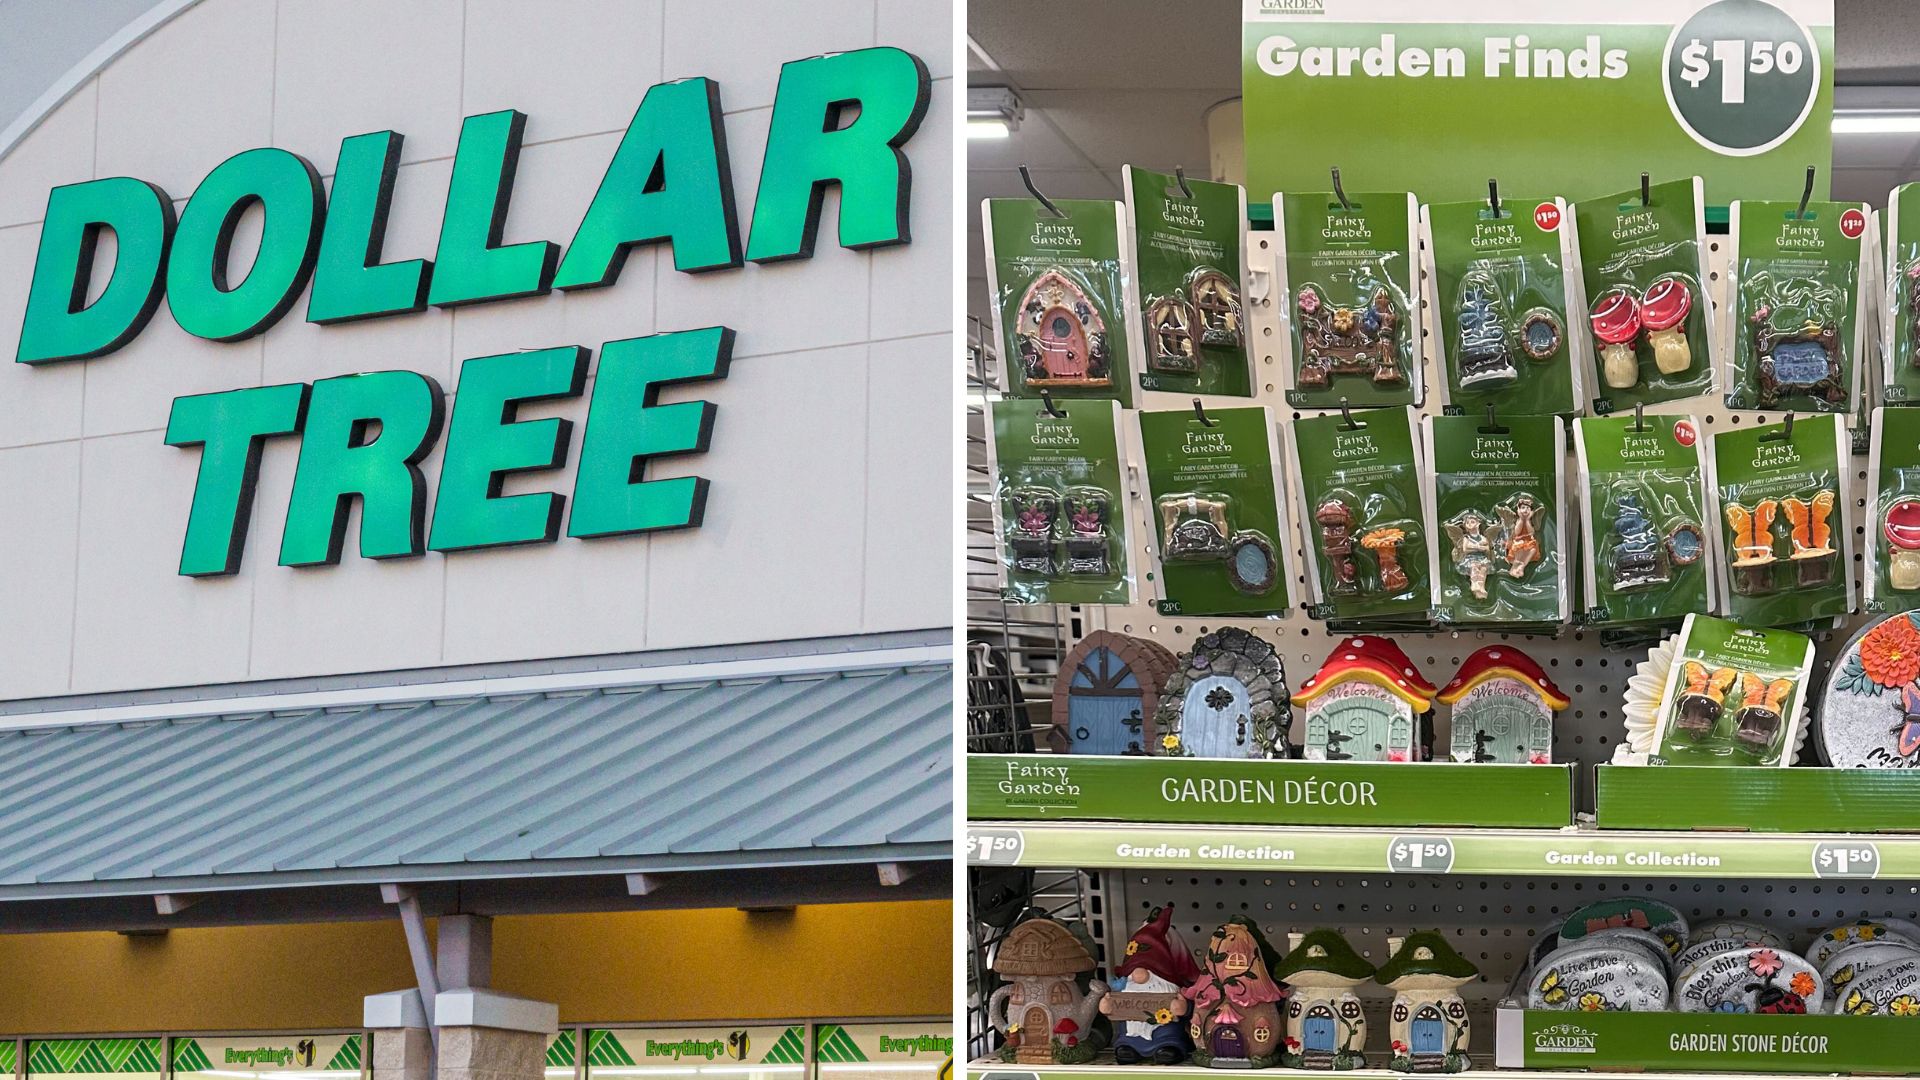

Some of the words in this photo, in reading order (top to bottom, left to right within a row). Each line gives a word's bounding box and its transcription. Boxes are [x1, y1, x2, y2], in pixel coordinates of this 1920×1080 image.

[1256, 34, 1465, 76] Garden
[1485, 35, 1628, 79] Finds
[16, 46, 931, 366] DOLLAR
[1164, 199, 1198, 219] Fairy
[1162, 211, 1205, 226] Garden
[1327, 216, 1365, 230] Fairy
[1616, 212, 1652, 229] Fairy
[1035, 222, 1074, 238] Fairy
[1322, 228, 1371, 238] Garden
[1475, 224, 1514, 237] Fairy
[1612, 222, 1660, 240] Garden
[1782, 224, 1819, 240] Fairy
[1031, 234, 1081, 245] Garden
[1471, 235, 1521, 246] Garden
[1776, 237, 1825, 247] Garden
[1142, 376, 1159, 388] 2PC
[1290, 393, 1307, 403] 1PC
[1596, 400, 1612, 411] 2PC
[1035, 423, 1073, 438] Fairy
[1031, 434, 1080, 445] Garden
[1186, 432, 1224, 446] Fairy
[1336, 435, 1371, 449] Fairy
[1476, 438, 1513, 453] Fairy
[1624, 437, 1658, 450] Fairy
[164, 325, 737, 577] TREE
[1181, 443, 1232, 454] Garden
[1332, 446, 1379, 458] Garden
[1471, 449, 1519, 459] Garden
[1620, 448, 1665, 458] Garden
[1757, 444, 1794, 459] Fairy
[1752, 454, 1801, 468] Garden
[1162, 602, 1181, 612] 2PC
[1319, 606, 1336, 615] 2PC
[1435, 607, 1453, 617] 2PC
[1868, 600, 1886, 610] 2PC
[1592, 609, 1607, 619] 2PC
[1723, 641, 1770, 655] Garden
[1731, 635, 1766, 651] Fairy
[1328, 681, 1387, 701] Welcome
[1472, 678, 1529, 701] Welcome
[1006, 762, 1069, 785] Fairy
[998, 780, 1080, 795] Garden
[1161, 777, 1275, 804] GARDEN
[1284, 776, 1378, 806] DÉCOR
[1116, 843, 1190, 858] Garden
[1198, 844, 1295, 861] Collection
[1545, 850, 1618, 865] Garden
[1625, 851, 1721, 867] Collection
[1710, 940, 1734, 952] this
[1590, 955, 1619, 969] Love
[1888, 961, 1915, 977] Love
[1568, 971, 1615, 997] Garden
[1686, 970, 1715, 1001] Bless
[1711, 956, 1738, 974] this
[1704, 971, 1749, 1008] Garden
[1874, 974, 1918, 1007] Garden
[646, 1038, 724, 1060] Everything's
[729, 1030, 749, 1061] $1
[880, 1034, 953, 1056] Everything
[1535, 1034, 1595, 1048] GARDEN
[1669, 1032, 1727, 1053] GARDEN
[1732, 1033, 1777, 1053] STONE
[1782, 1031, 1828, 1053] DÉCOR
[225, 1047, 293, 1067] Everything's
[299, 1039, 315, 1068] $1
